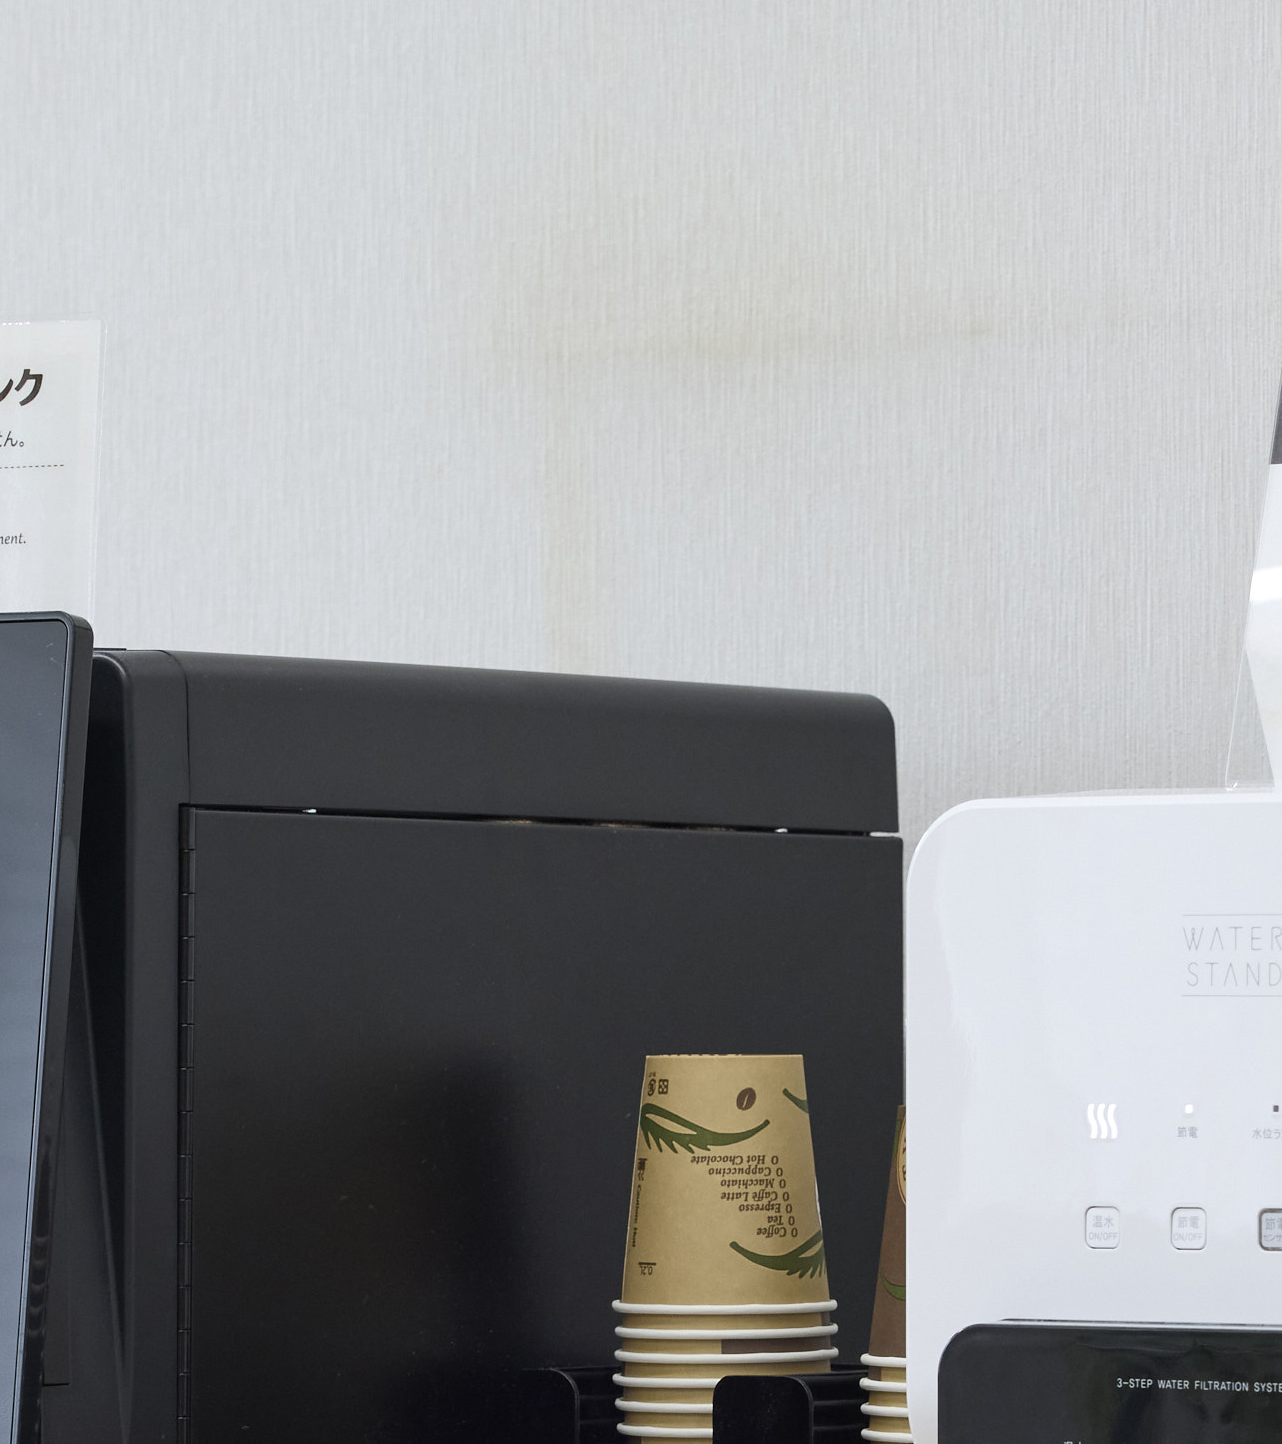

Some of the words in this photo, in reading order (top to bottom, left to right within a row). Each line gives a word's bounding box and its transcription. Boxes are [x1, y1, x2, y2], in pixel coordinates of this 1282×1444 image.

[1177, 1126, 1198, 1138] 節電
[690, 1155, 744, 1166] Chocolate
[747, 1155, 766, 1165] Hot
[708, 1165, 772, 1177] Cappuccino
[720, 1178, 775, 1189] Macchiato
[720, 1191, 749, 1201] Latte
[752, 1188, 778, 1202] Caffè
[739, 1201, 781, 1213] Espresso
[767, 1215, 784, 1225] Tea
[1092, 1215, 1114, 1228] 温水
[756, 1224, 787, 1238] Coffee
[1088, 1231, 1118, 1241] ON/OFF
[1173, 1231, 1203, 1242] ON/OFF
[1117, 1378, 1153, 1389] 3-STEP
[1157, 1379, 1190, 1390] WATER
[1194, 1380, 1249, 1391] FILTRATION
